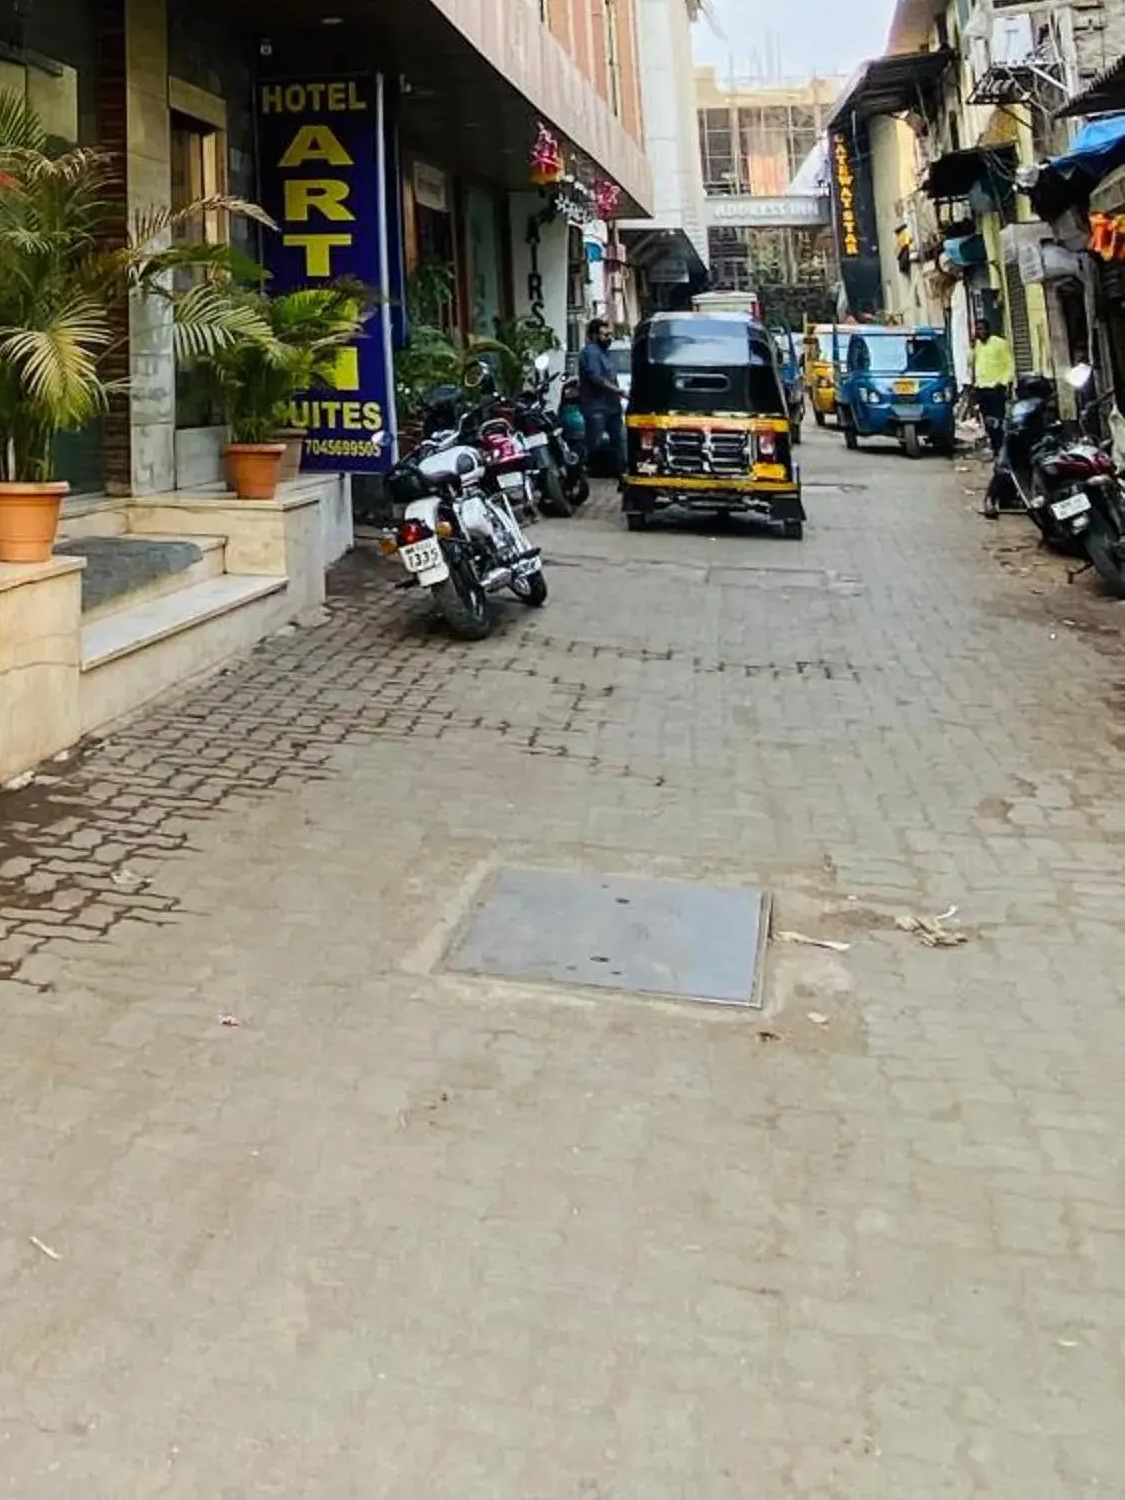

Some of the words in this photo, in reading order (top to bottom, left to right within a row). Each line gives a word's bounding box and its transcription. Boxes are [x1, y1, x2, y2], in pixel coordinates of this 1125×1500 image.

[262, 81, 367, 113] HOTEL
[276, 124, 360, 391] ARTN
[279, 400, 382, 431] UITES
